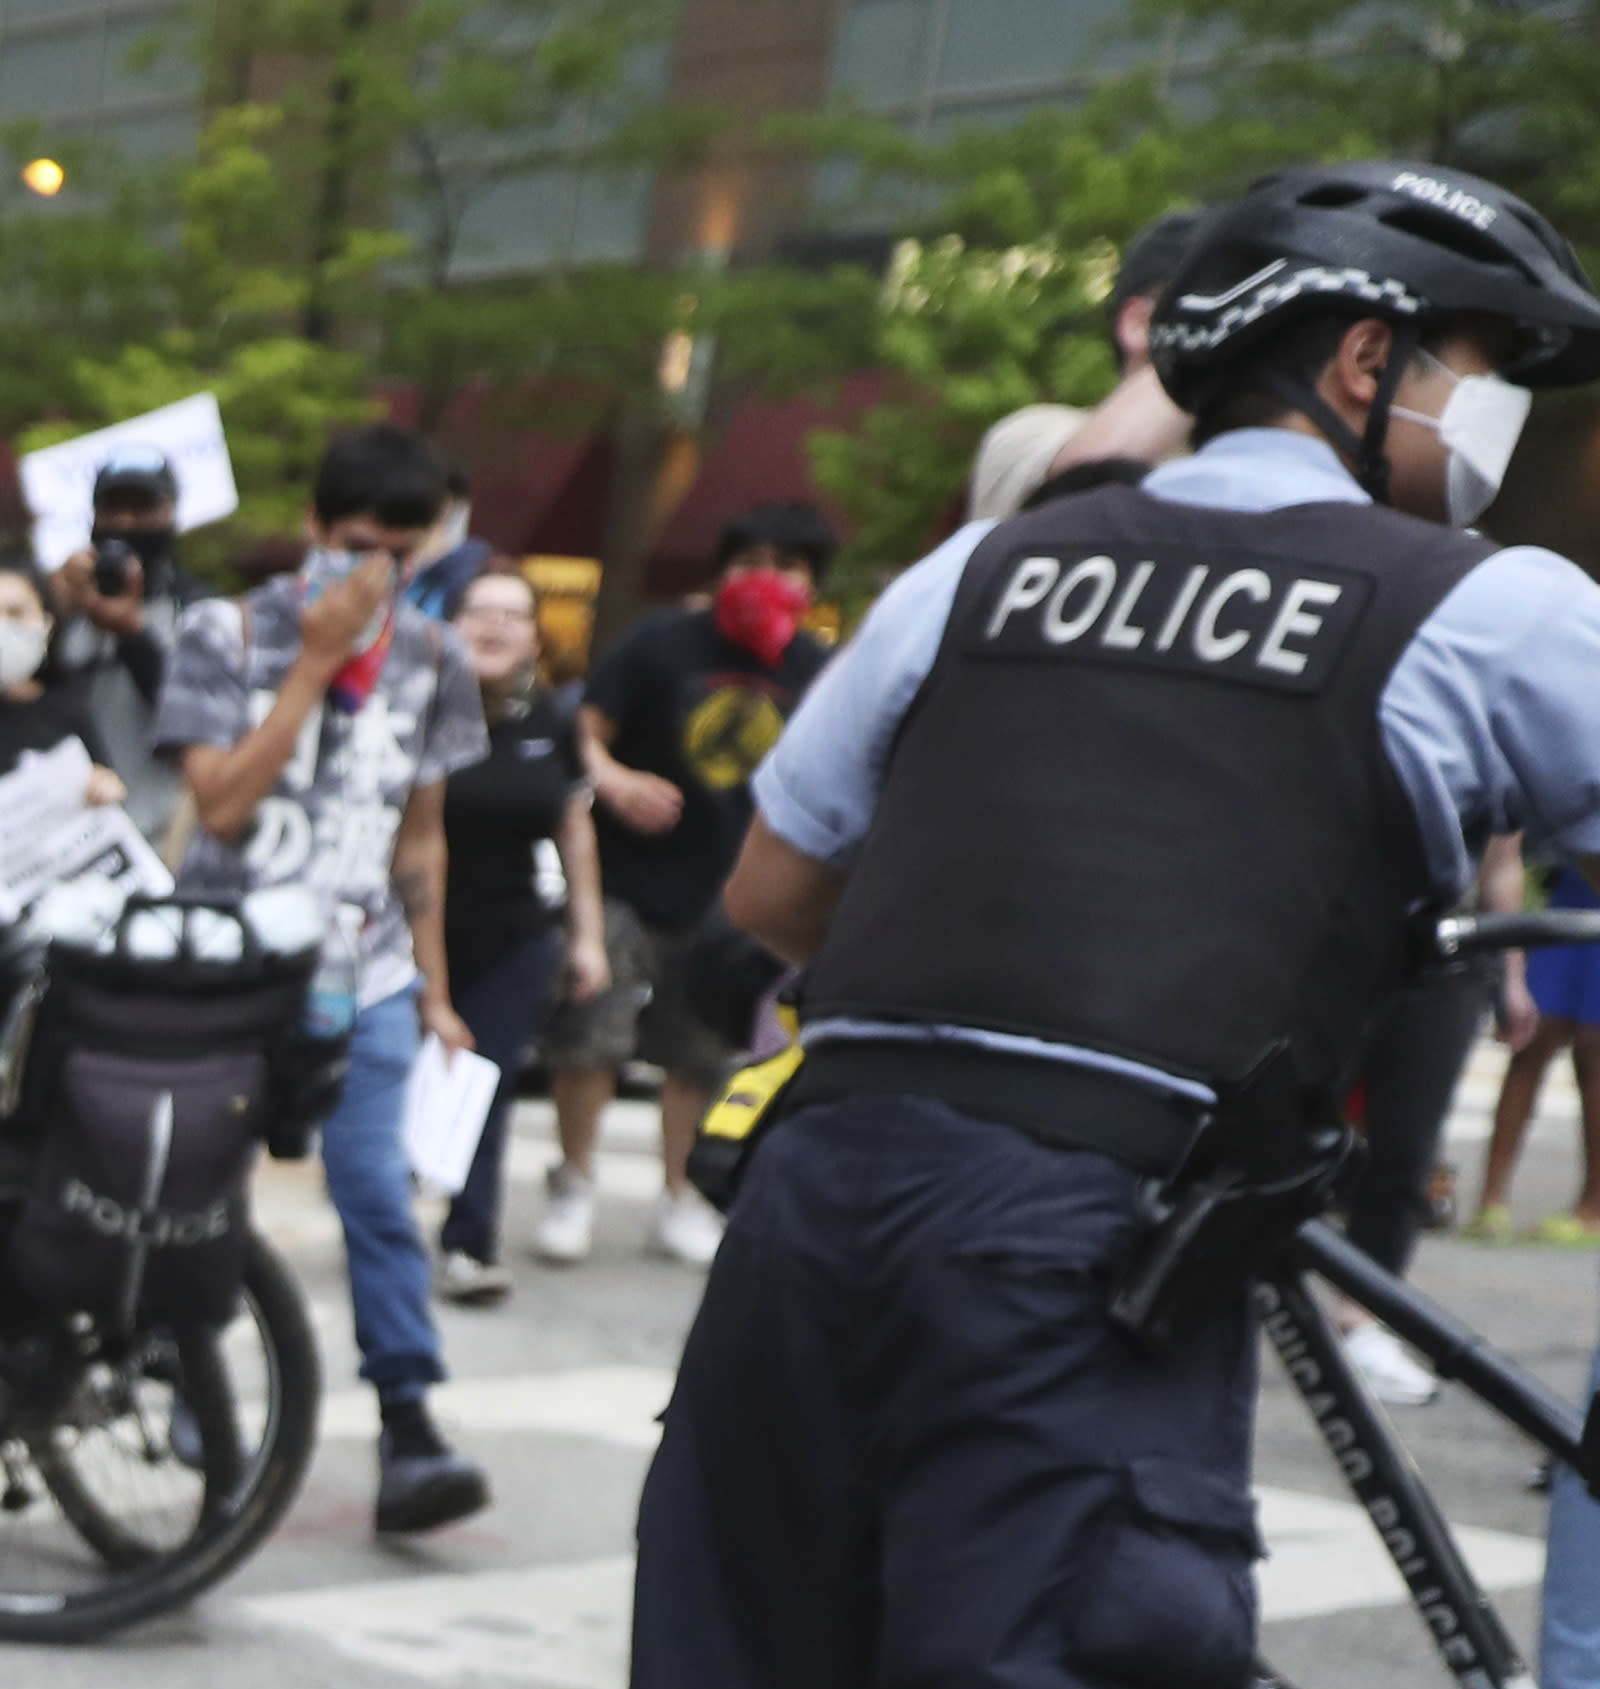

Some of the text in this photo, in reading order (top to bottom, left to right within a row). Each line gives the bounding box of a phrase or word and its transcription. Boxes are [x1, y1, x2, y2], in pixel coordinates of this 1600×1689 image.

[1391, 171, 1497, 231] POLICE
[985, 555, 1343, 675] POLICE
[61, 1176, 230, 1247] POLICE
[1252, 1281, 1478, 1673] CHICAGO POLICE
